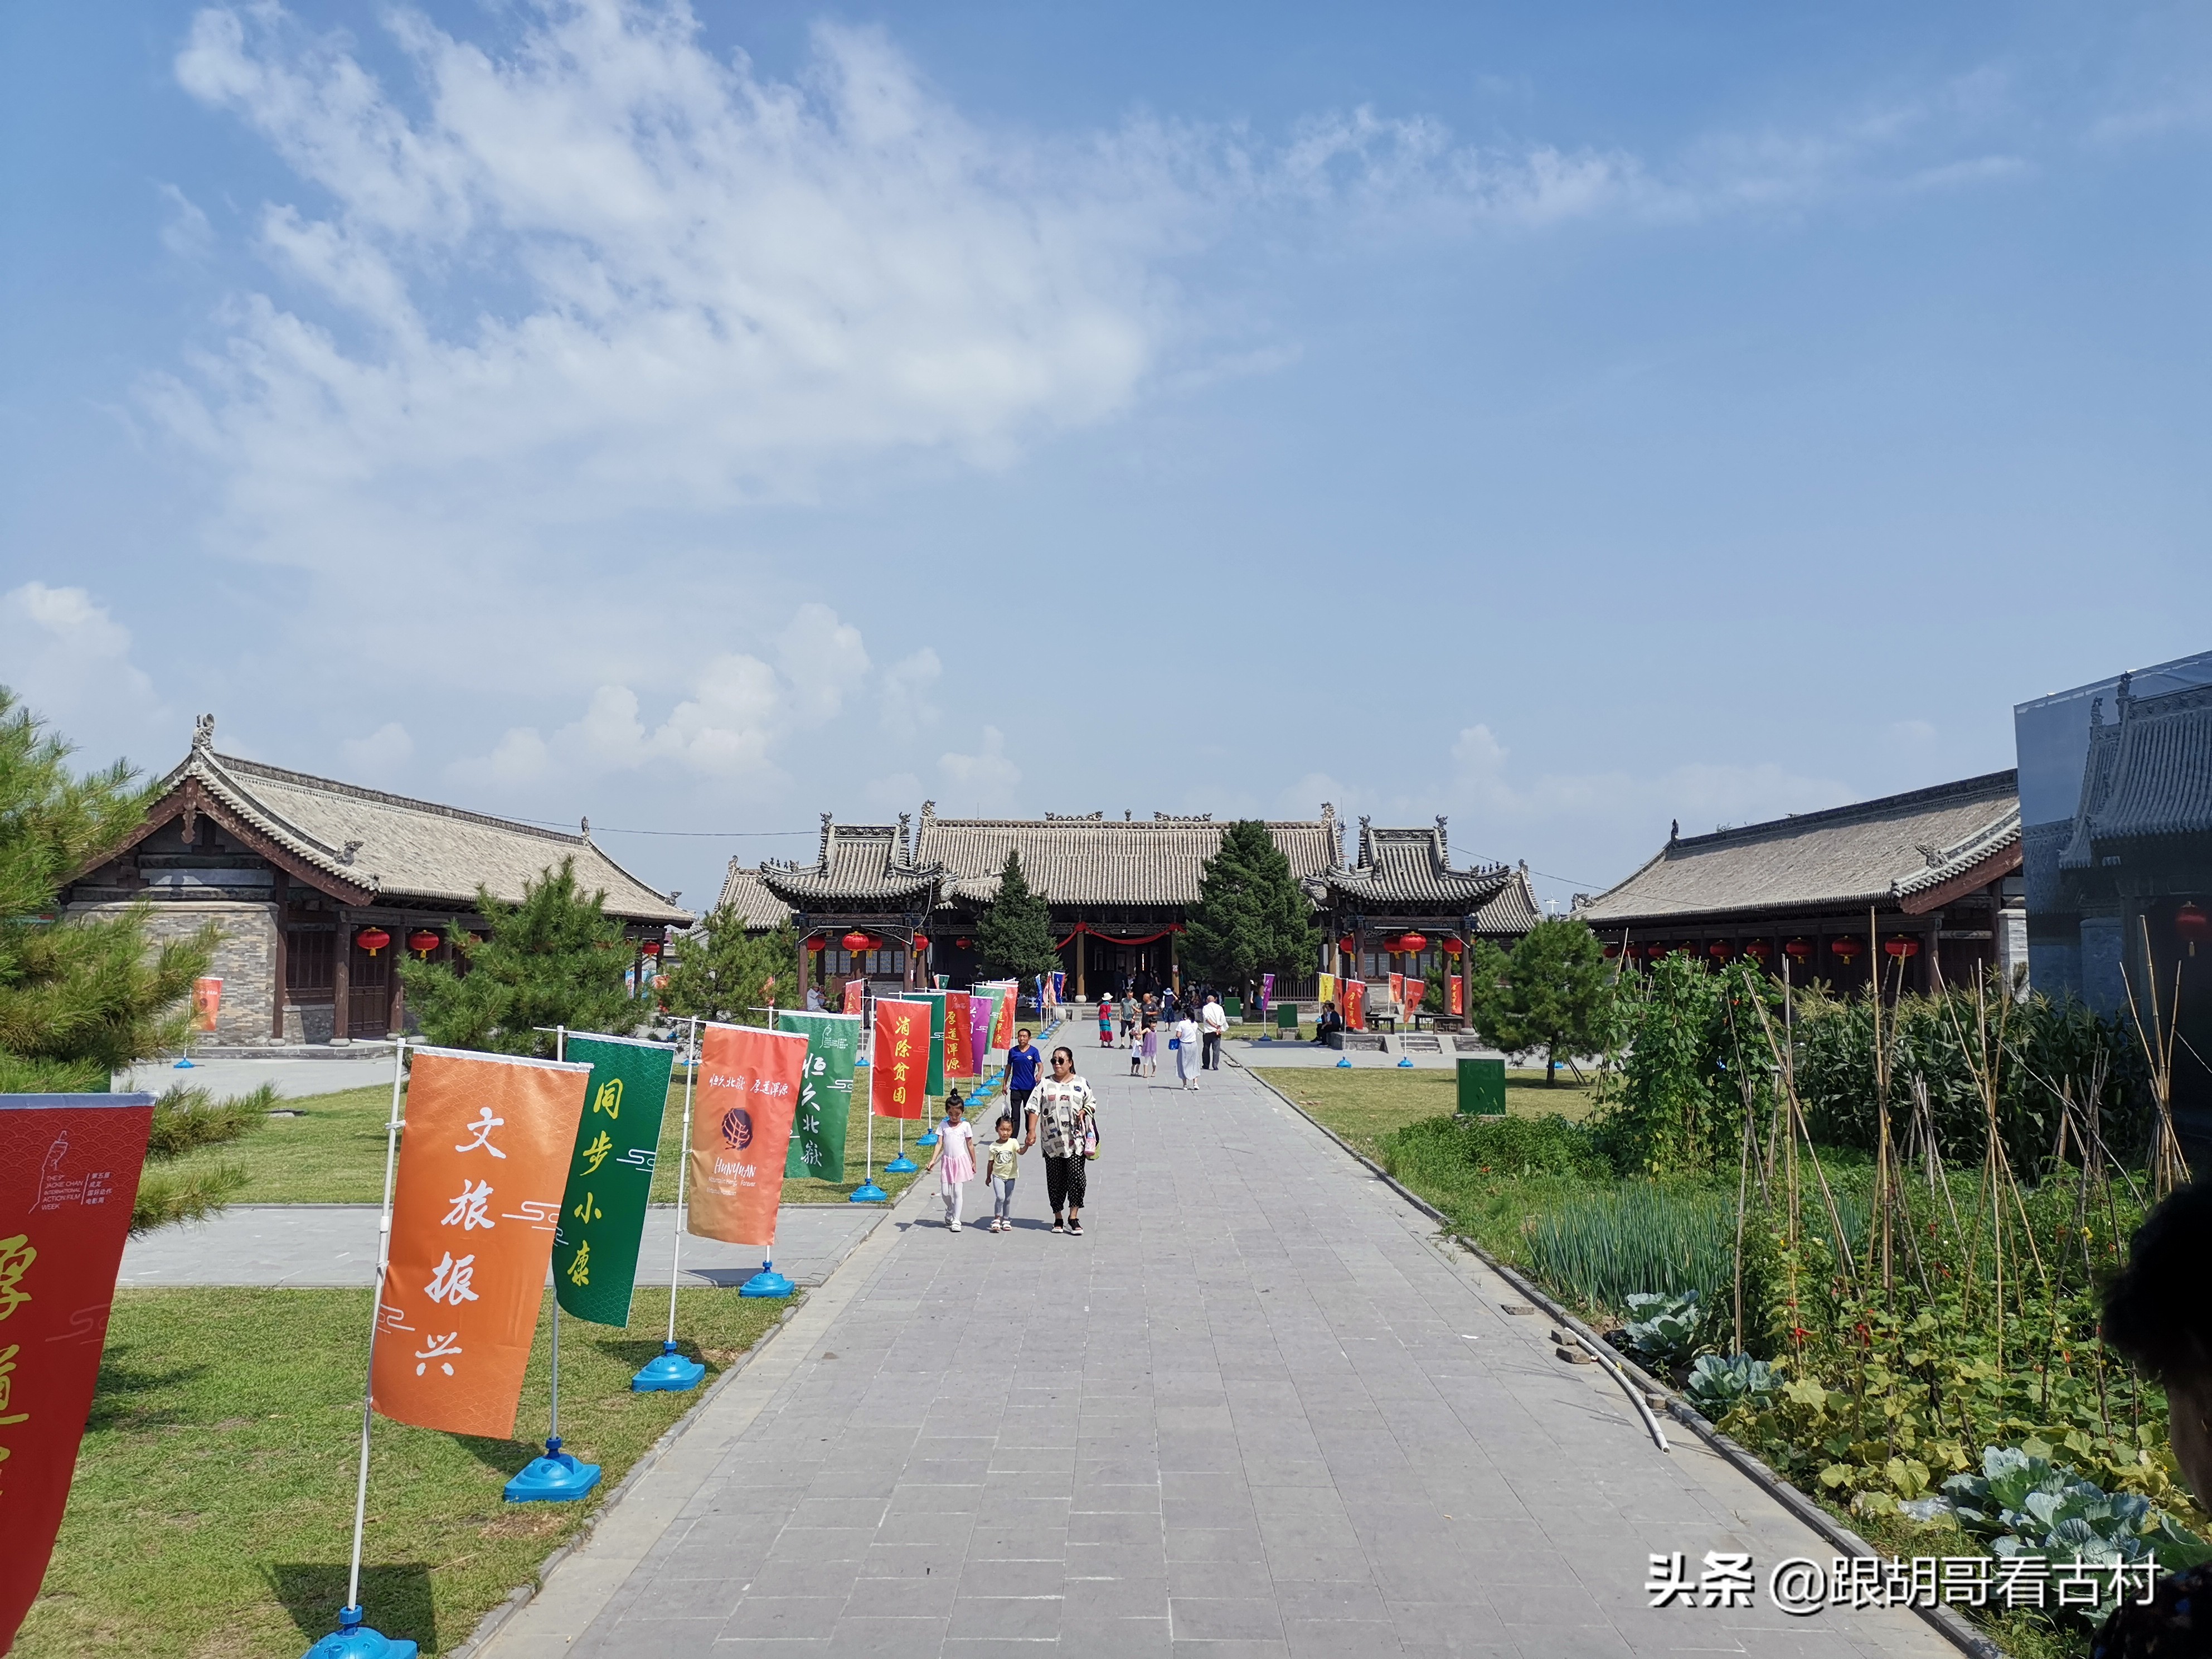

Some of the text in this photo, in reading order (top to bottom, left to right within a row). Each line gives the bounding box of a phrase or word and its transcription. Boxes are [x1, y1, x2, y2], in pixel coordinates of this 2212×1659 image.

[893, 1016, 912, 1104] 消除贫困
[944, 1011, 960, 1071] 厚道渾源
[415, 1107, 506, 1376] 文旅振兴
[567, 1078, 623, 1286] 同步小康
